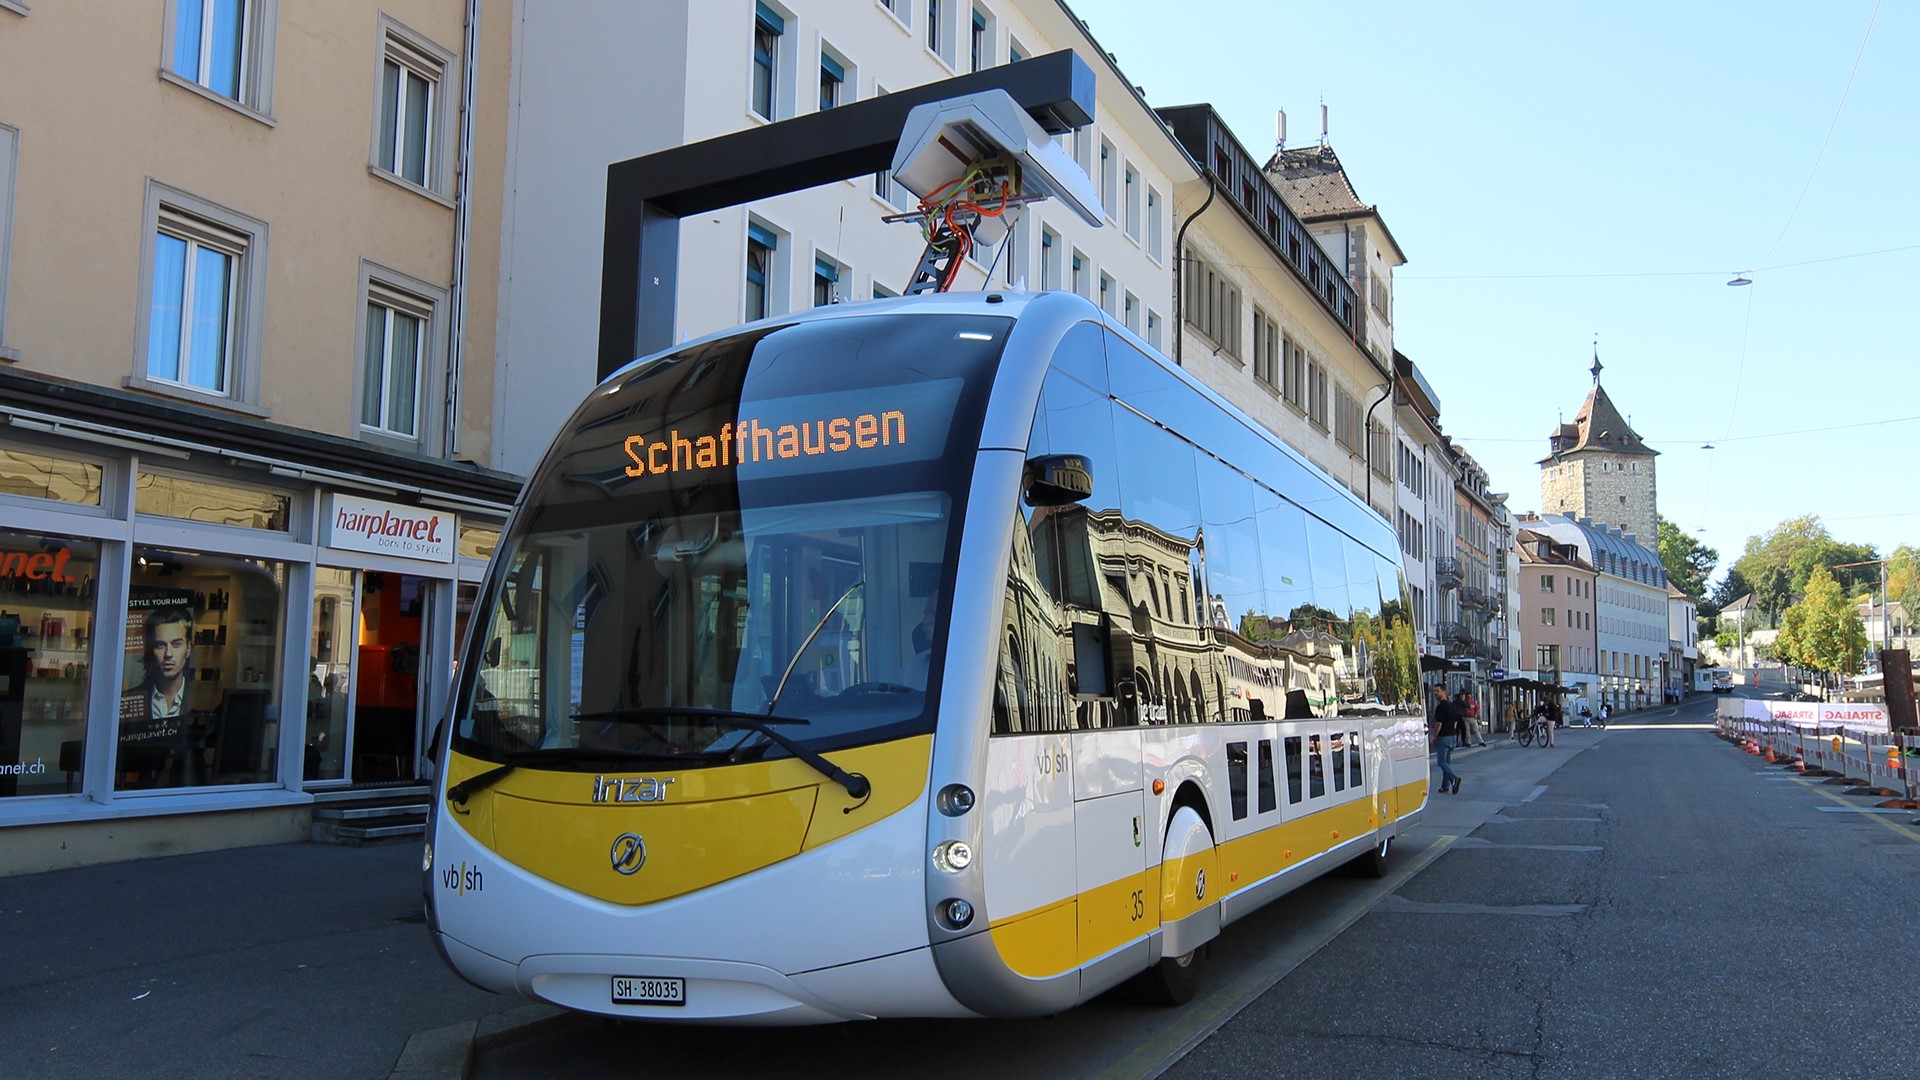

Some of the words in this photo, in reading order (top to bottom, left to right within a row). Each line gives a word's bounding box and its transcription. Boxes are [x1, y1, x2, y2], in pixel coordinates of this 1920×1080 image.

[624, 409, 906, 478] Schaffhausen
[402, 541, 413, 551] to
[0, 547, 77, 583] net.
[128, 599, 151, 607] STYLE
[152, 598, 171, 606] YOUR
[171, 597, 188, 605] HAIR
[1131, 889, 1144, 921] 35
